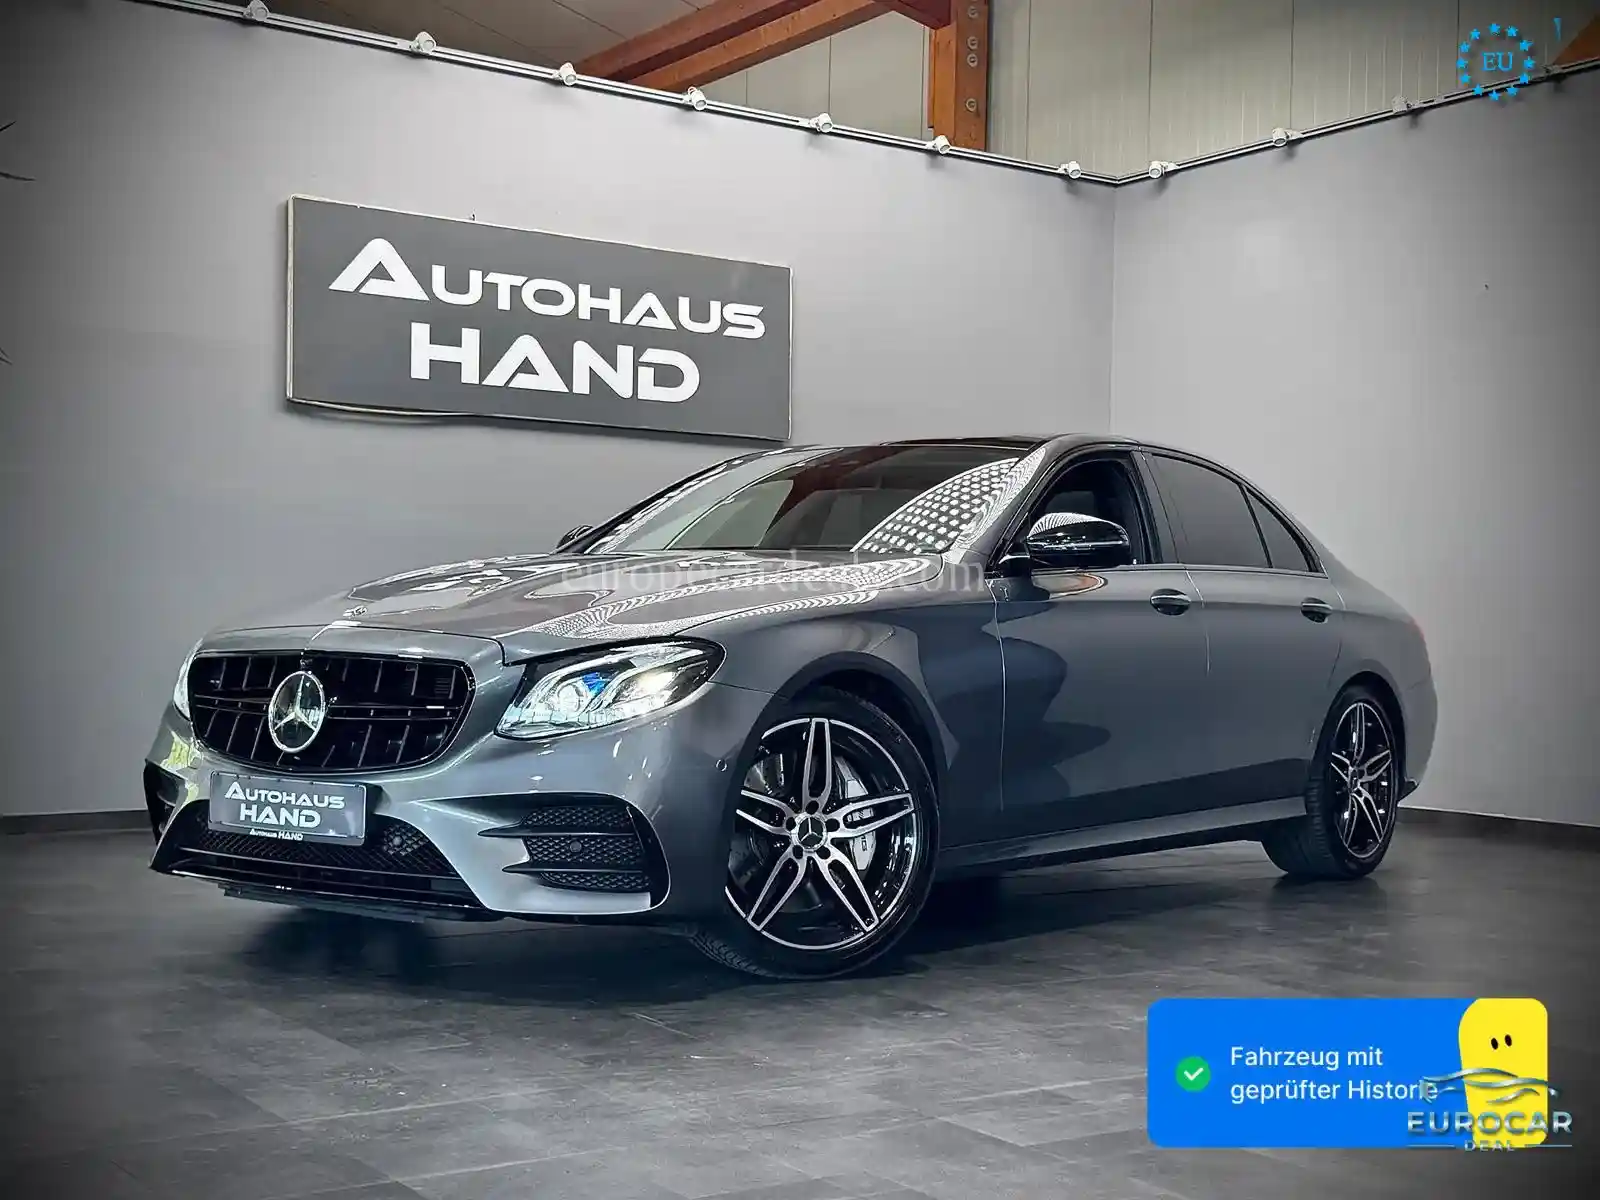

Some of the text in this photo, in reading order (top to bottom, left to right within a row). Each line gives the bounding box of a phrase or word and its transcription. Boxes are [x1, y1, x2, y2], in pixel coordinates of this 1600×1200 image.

[329, 238, 765, 339] AUTOHAUS
[411, 322, 700, 403] HAND
[224, 781, 345, 810] AUTOHAUS
[239, 803, 321, 828] HAND
[278, 830, 303, 841] HAND
